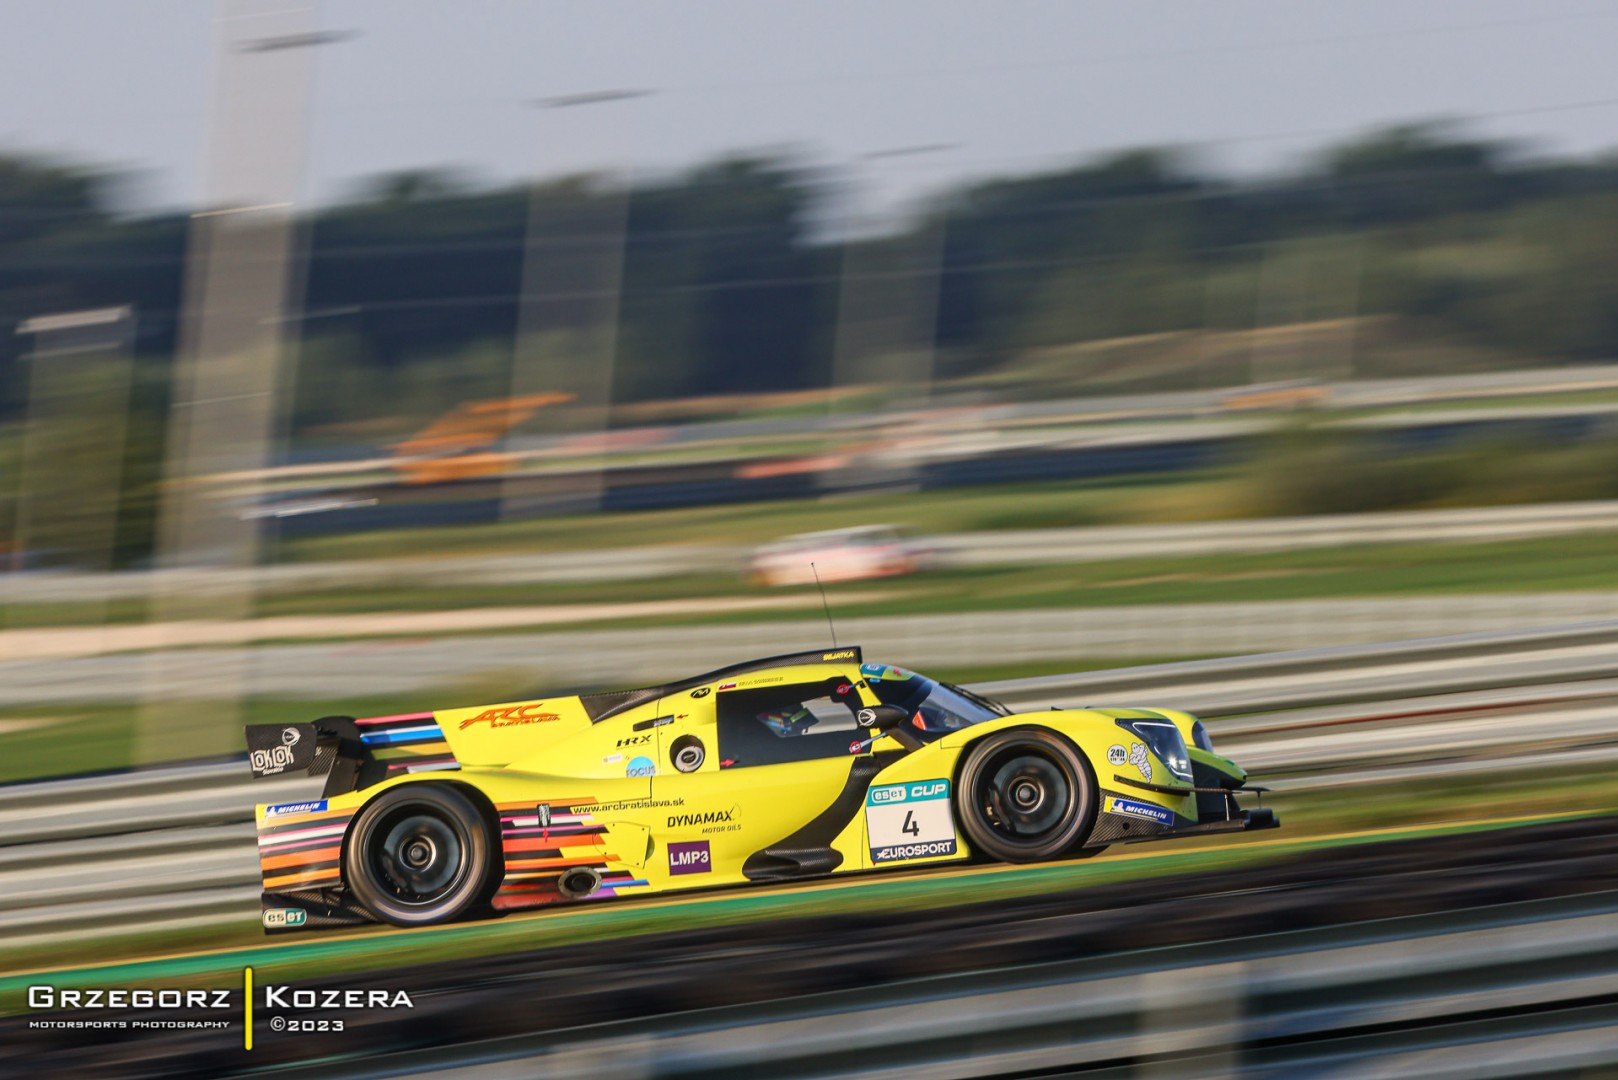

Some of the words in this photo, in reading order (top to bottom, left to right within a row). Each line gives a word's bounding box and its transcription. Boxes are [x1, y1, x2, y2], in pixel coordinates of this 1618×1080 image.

[616, 734, 652, 747] HRX
[1110, 749, 1125, 757] 24h
[911, 784, 946, 797] CUP
[277, 802, 321, 814] MICHELIN
[573, 797, 685, 814] www.arcbratislava.sk
[1125, 805, 1167, 819] MICHELIN
[667, 806, 734, 828] DYNAMAX
[902, 810, 920, 837] 4
[702, 826, 726, 834] MOTOR
[877, 842, 952, 859] EUROSPORT
[669, 850, 709, 866] LMP3
